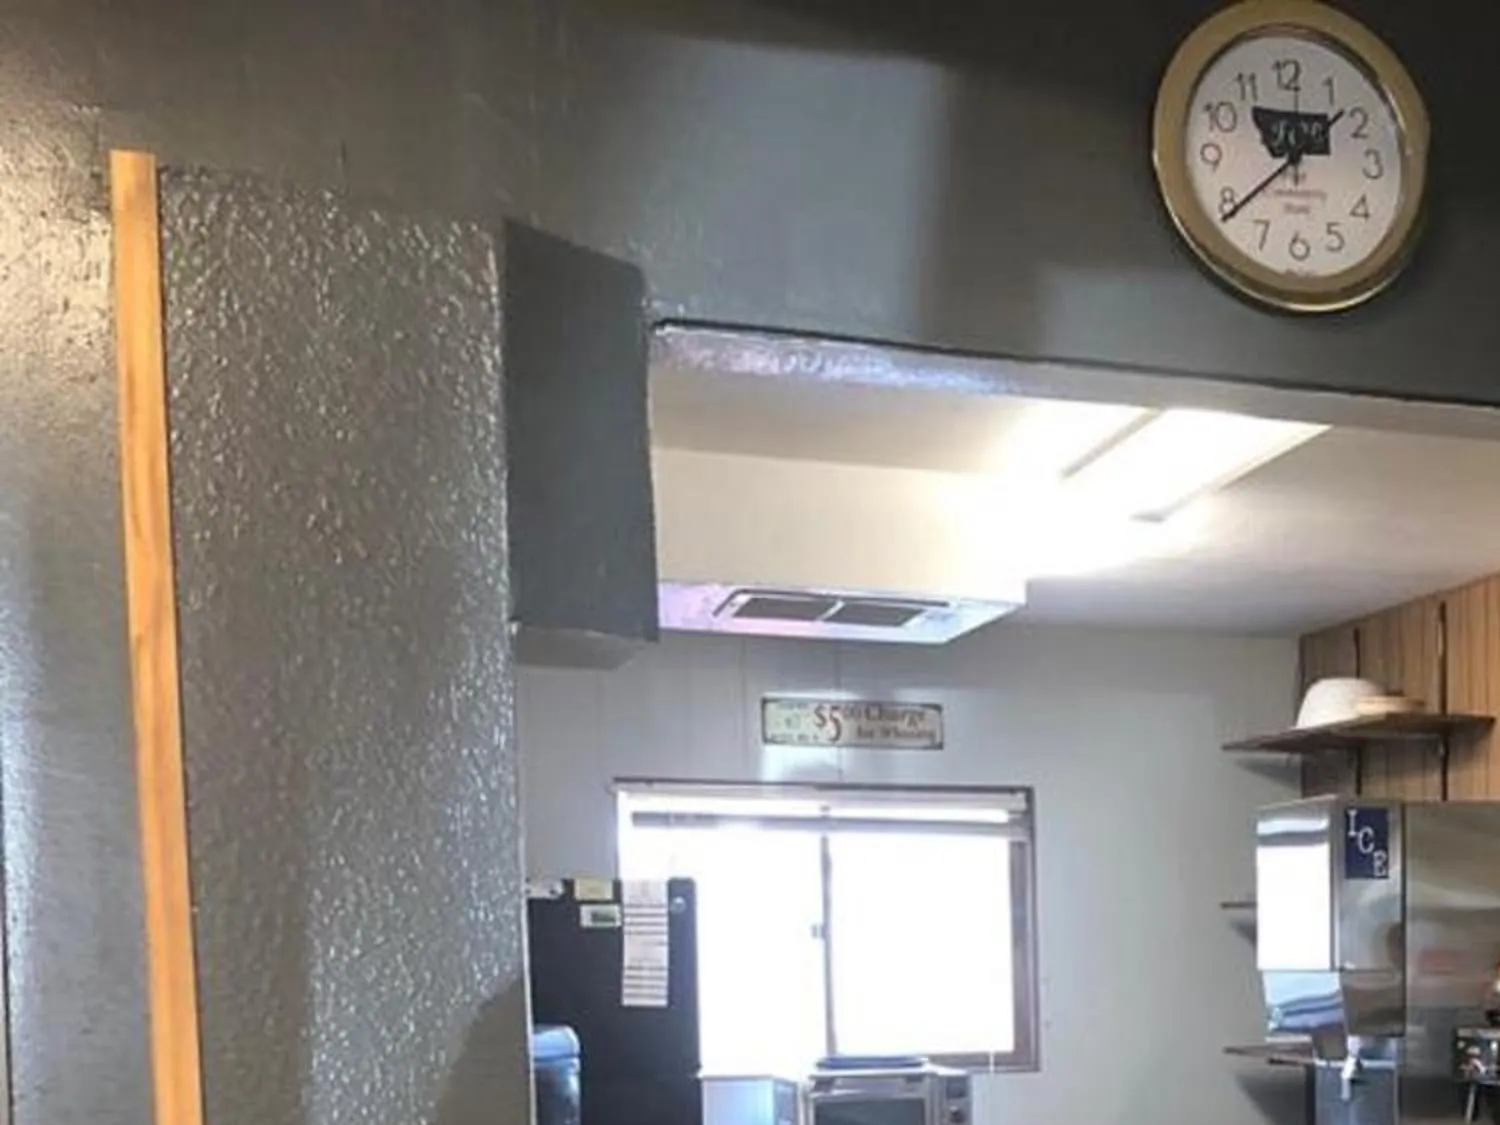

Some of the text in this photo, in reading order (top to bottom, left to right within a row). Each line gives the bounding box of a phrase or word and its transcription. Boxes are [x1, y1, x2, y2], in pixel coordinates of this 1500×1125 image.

[1234, 72, 1259, 101] 11
[1272, 59, 1302, 91] 12
[1322, 76, 1335, 105] 1
[1202, 101, 1238, 133] 10
[1350, 106, 1369, 139] 2
[1200, 142, 1223, 172] 9
[1362, 149, 1384, 180] 3
[1218, 186, 1237, 215] 8
[1350, 194, 1370, 220] 4
[1252, 219, 1271, 251] 7
[1288, 234, 1311, 261] 6
[1326, 222, 1346, 252] 5
[1347, 809, 1387, 877] ICE
